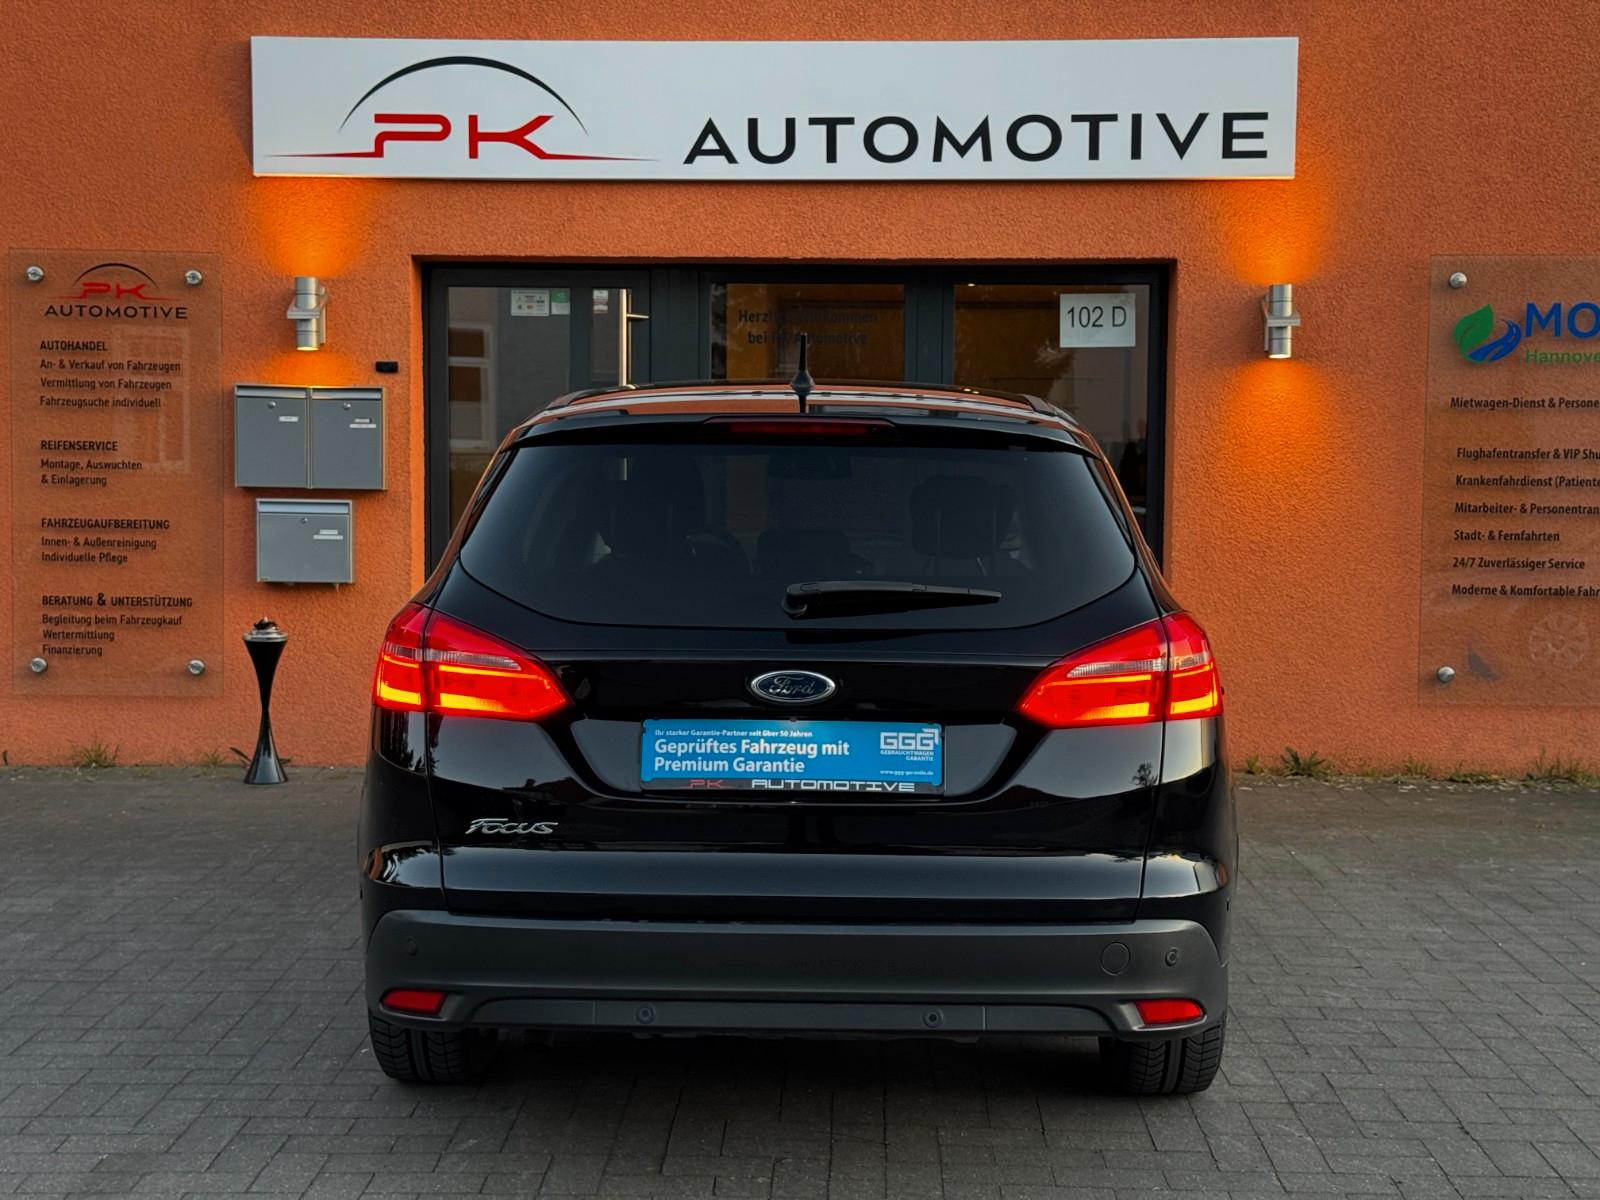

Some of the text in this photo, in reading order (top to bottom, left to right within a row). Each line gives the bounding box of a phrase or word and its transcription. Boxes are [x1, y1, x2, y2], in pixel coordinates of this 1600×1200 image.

[374, 111, 1270, 165] PK AUTOMOTIVE
[44, 305, 188, 319] AUTOMOTIVE
[1067, 306, 1127, 328] 102 D
[1525, 302, 1600, 338] MO
[748, 332, 767, 345] bei
[40, 341, 108, 351] AUTOHANDEL
[1526, 349, 1600, 364] Hannove
[40, 360, 181, 373] An- & Verkauf von Fahrzeugen
[41, 378, 172, 392] Vermittlung von Fahrzeugen
[40, 396, 161, 408] Fahrzeugsuche individuell
[1450, 397, 1545, 410] Mietwagen-Dienst
[1548, 397, 1558, 408] &
[41, 441, 118, 451] REIFENSERVICE
[1457, 448, 1550, 460] Flughafentransfer
[1553, 449, 1561, 460] &
[1563, 449, 1580, 460] VIP
[41, 459, 142, 471] Montage, Auswuchten
[41, 475, 107, 487] & Einlagerung
[1456, 475, 1552, 487] Krankenfahrdienst
[1455, 503, 1517, 513] Mitarbeiter-
[1520, 503, 1527, 514] &
[41, 518, 170, 530] FAHRZEUGAUFBEREITUNG
[1454, 530, 1560, 541] Stadt- & Fernfahrten
[41, 537, 157, 549] Innen- & Außenreinigung
[42, 553, 128, 564] Individuelle Pflege
[1453, 557, 1585, 571] 24/7 Zuverlässiger Service
[1452, 584, 1497, 595] Moderne
[1500, 585, 1508, 595] &
[1510, 585, 1575, 596] Komfortable
[42, 593, 193, 607] BERATUNG & UNTERSTÜTZUNG
[42, 614, 182, 628] Begleitung beim Fahrzeugkauf
[43, 630, 114, 641] Wertermittlung
[42, 645, 103, 656] Finanzierung
[769, 676, 816, 694] Ford
[691, 729, 748, 737] Garantie-Partner
[880, 731, 935, 750] GGG
[655, 738, 850, 758] Geprüftes Fahrzeug mit
[655, 757, 805, 772] Premium Garantie
[688, 779, 916, 792] PK AUTOMOTIVE
[465, 818, 559, 834] Focus
